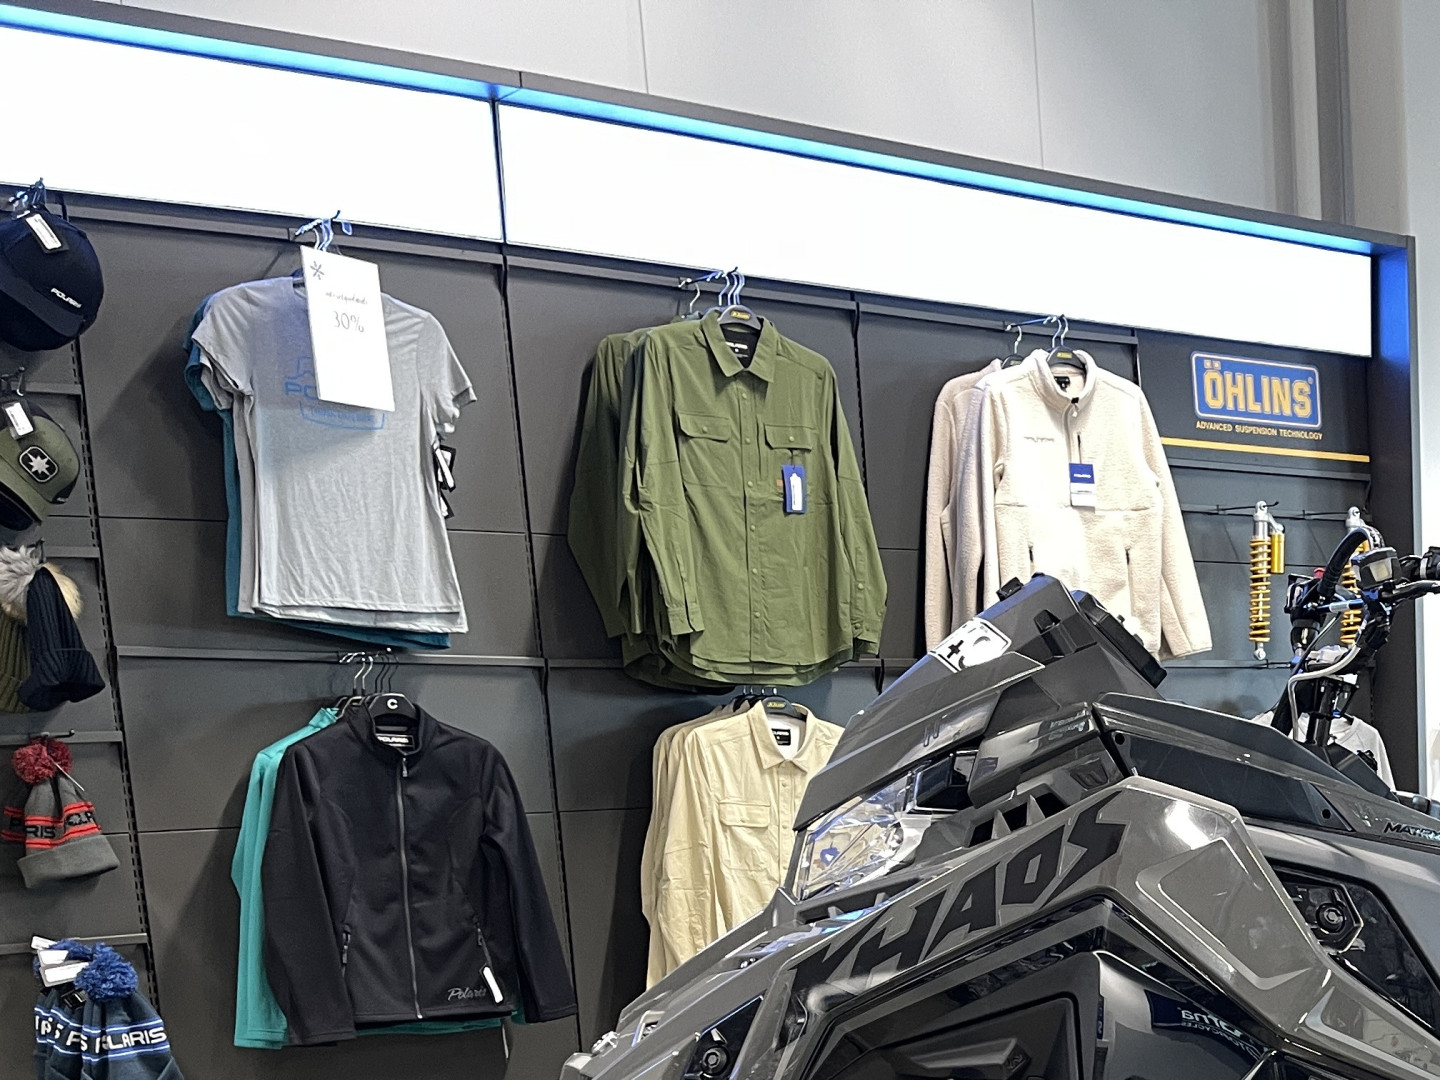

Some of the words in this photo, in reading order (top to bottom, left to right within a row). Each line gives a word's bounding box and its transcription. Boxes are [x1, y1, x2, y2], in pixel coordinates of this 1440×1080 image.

[332, 311, 365, 333] 30%
[1203, 359, 1312, 418] ÖHLINS
[1196, 420, 1233, 432] ADVANCED
[1235, 424, 1278, 436] SUSPENSION
[1279, 428, 1323, 440] TECHNOLOGY
